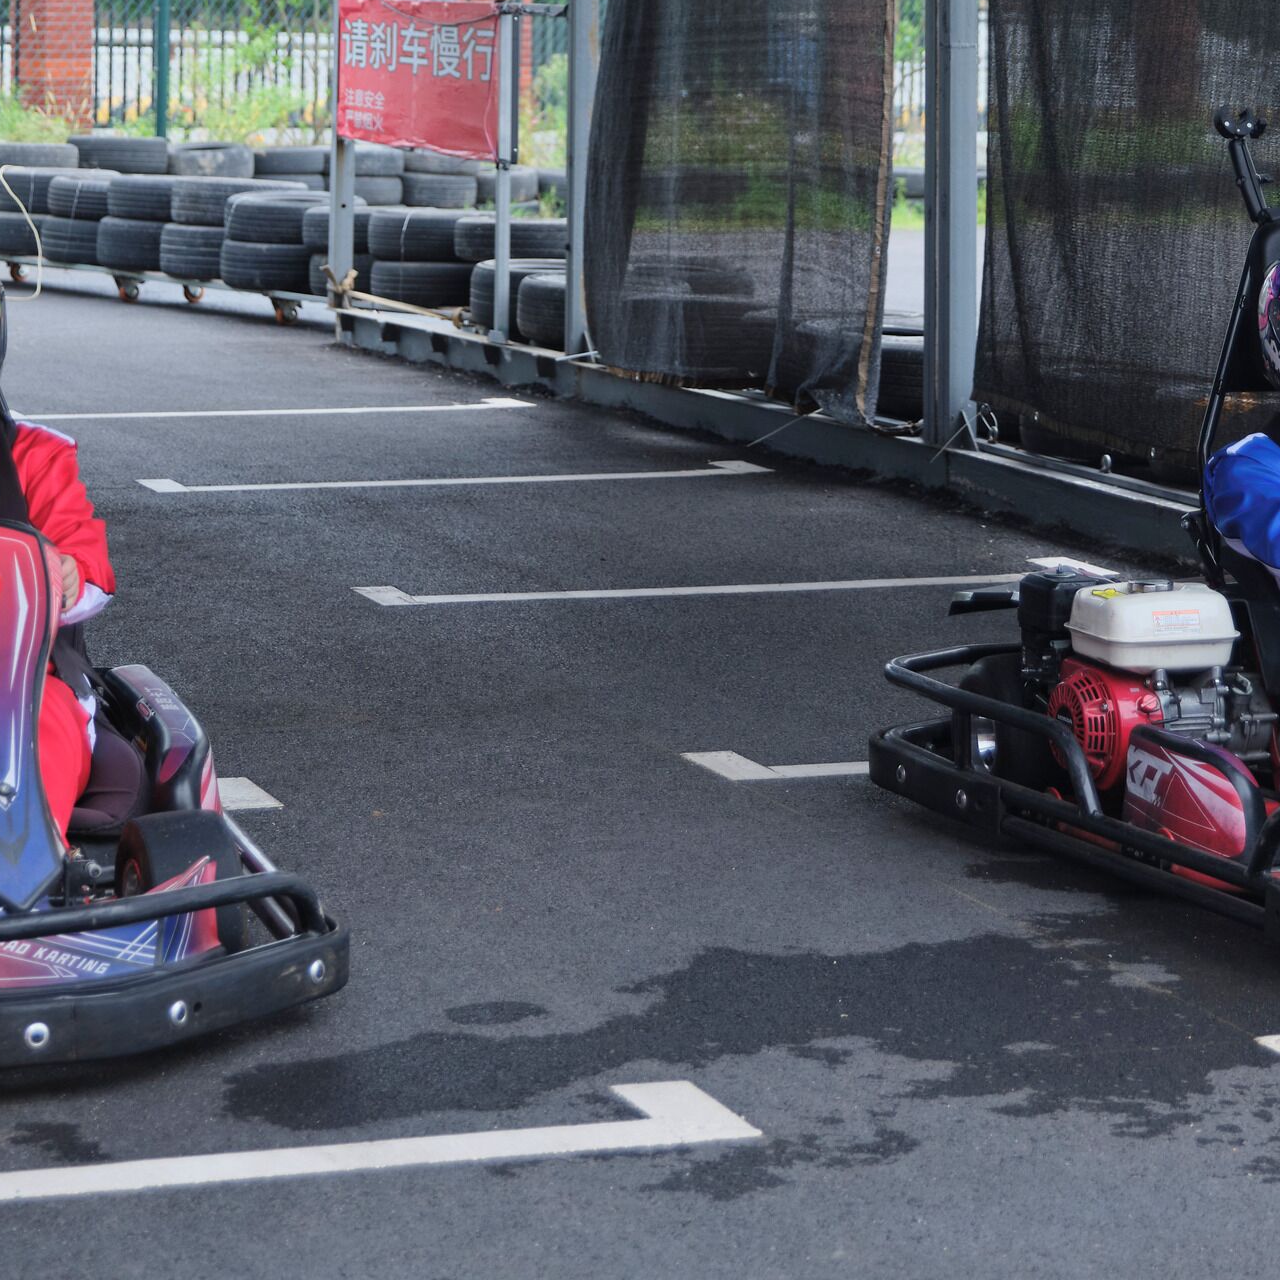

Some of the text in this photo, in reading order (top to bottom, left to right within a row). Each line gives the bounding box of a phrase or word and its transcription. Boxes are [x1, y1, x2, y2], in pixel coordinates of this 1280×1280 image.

[341, 18, 496, 82] 请刹车慢行
[344, 87, 385, 110] 注意安全
[33, 946, 112, 975] KARTING
